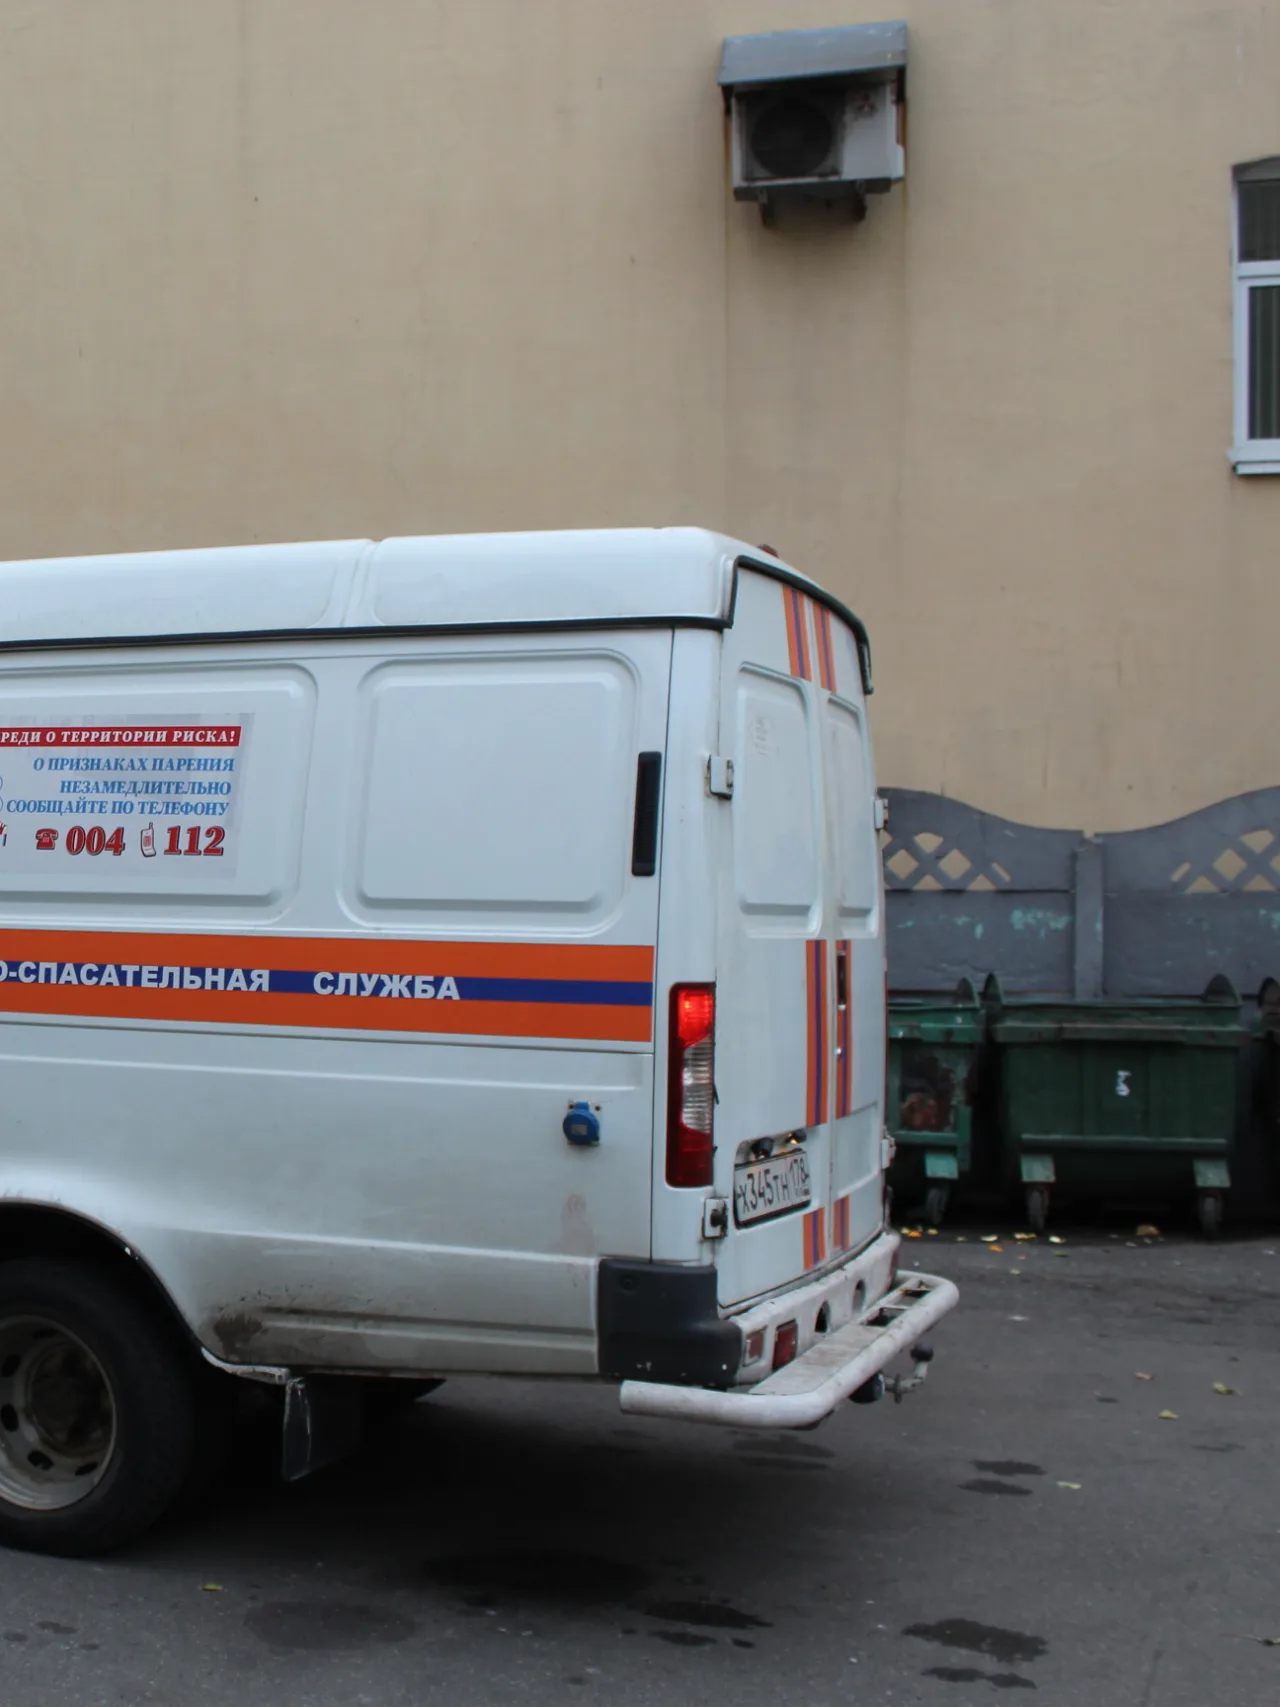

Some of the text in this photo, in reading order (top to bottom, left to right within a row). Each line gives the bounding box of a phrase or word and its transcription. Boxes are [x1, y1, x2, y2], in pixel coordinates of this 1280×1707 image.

[45, 731, 57, 743] О
[61, 730, 169, 743] ТЕРРИТОРИИ
[172, 729, 236, 742] РИСКА!
[33, 758, 235, 772] О ПРИЗНАКАХ ПАРЕНИЯ
[60, 780, 231, 796] НЕЗАМЕДЛИТЕЛЬНО
[6, 797, 230, 816] СООБЩАЙТЕ ПО ТЕЛЕФОНУ
[65, 825, 225, 856] 004 112
[312, 971, 461, 1000] СЛУЖБА
